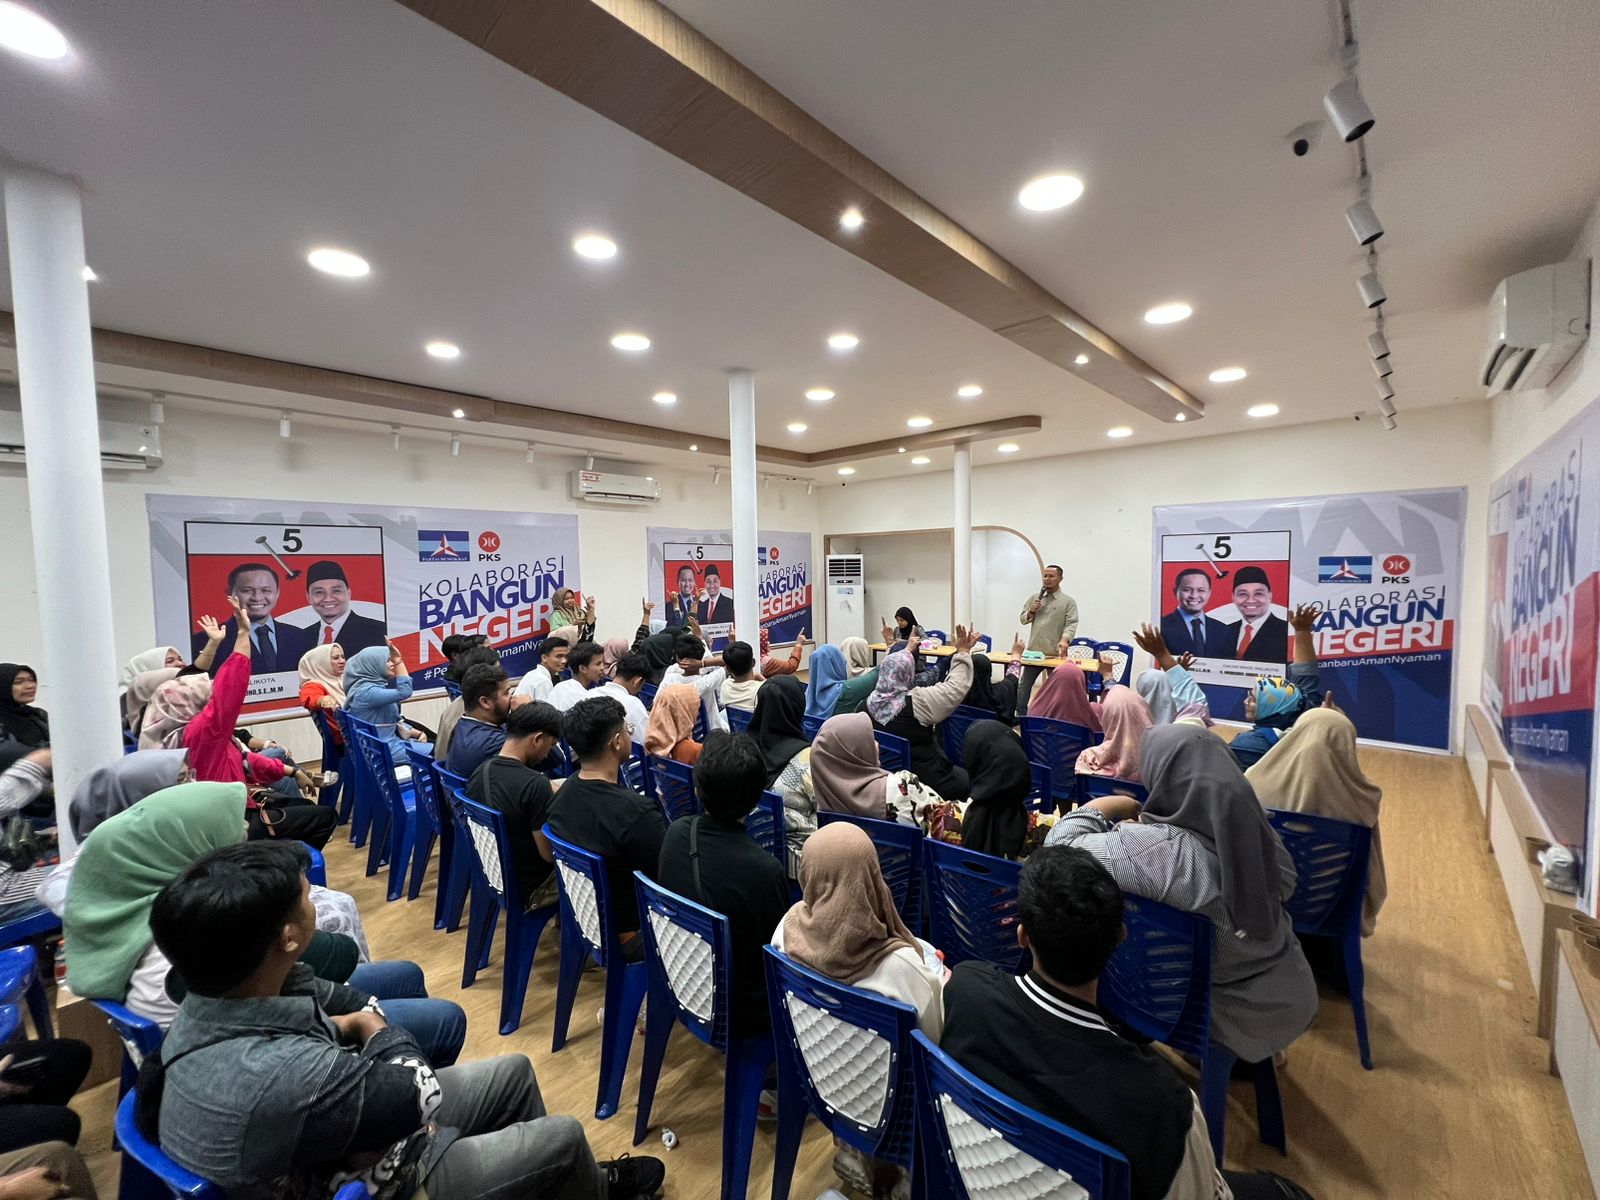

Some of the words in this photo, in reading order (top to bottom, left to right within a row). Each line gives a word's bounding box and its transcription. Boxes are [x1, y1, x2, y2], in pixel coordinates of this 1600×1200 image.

[283, 529, 302, 552] 5
[696, 546, 704, 560] 5
[1214, 536, 1231, 559] 5
[478, 554, 501, 562] PKS
[1512, 494, 1581, 633] BANGUN
[419, 556, 564, 601] KOLABORASI
[759, 571, 806, 599] ANGUN
[760, 562, 807, 584] LABORASI
[1382, 576, 1410, 584] PKS
[419, 570, 565, 631] BANGUN
[759, 587, 807, 620] EGERI
[1312, 598, 1445, 633] ANGUN
[419, 602, 551, 665] NEGER
[1509, 585, 1575, 705] NEGERI
[250, 677, 276, 686] LIKOTA
